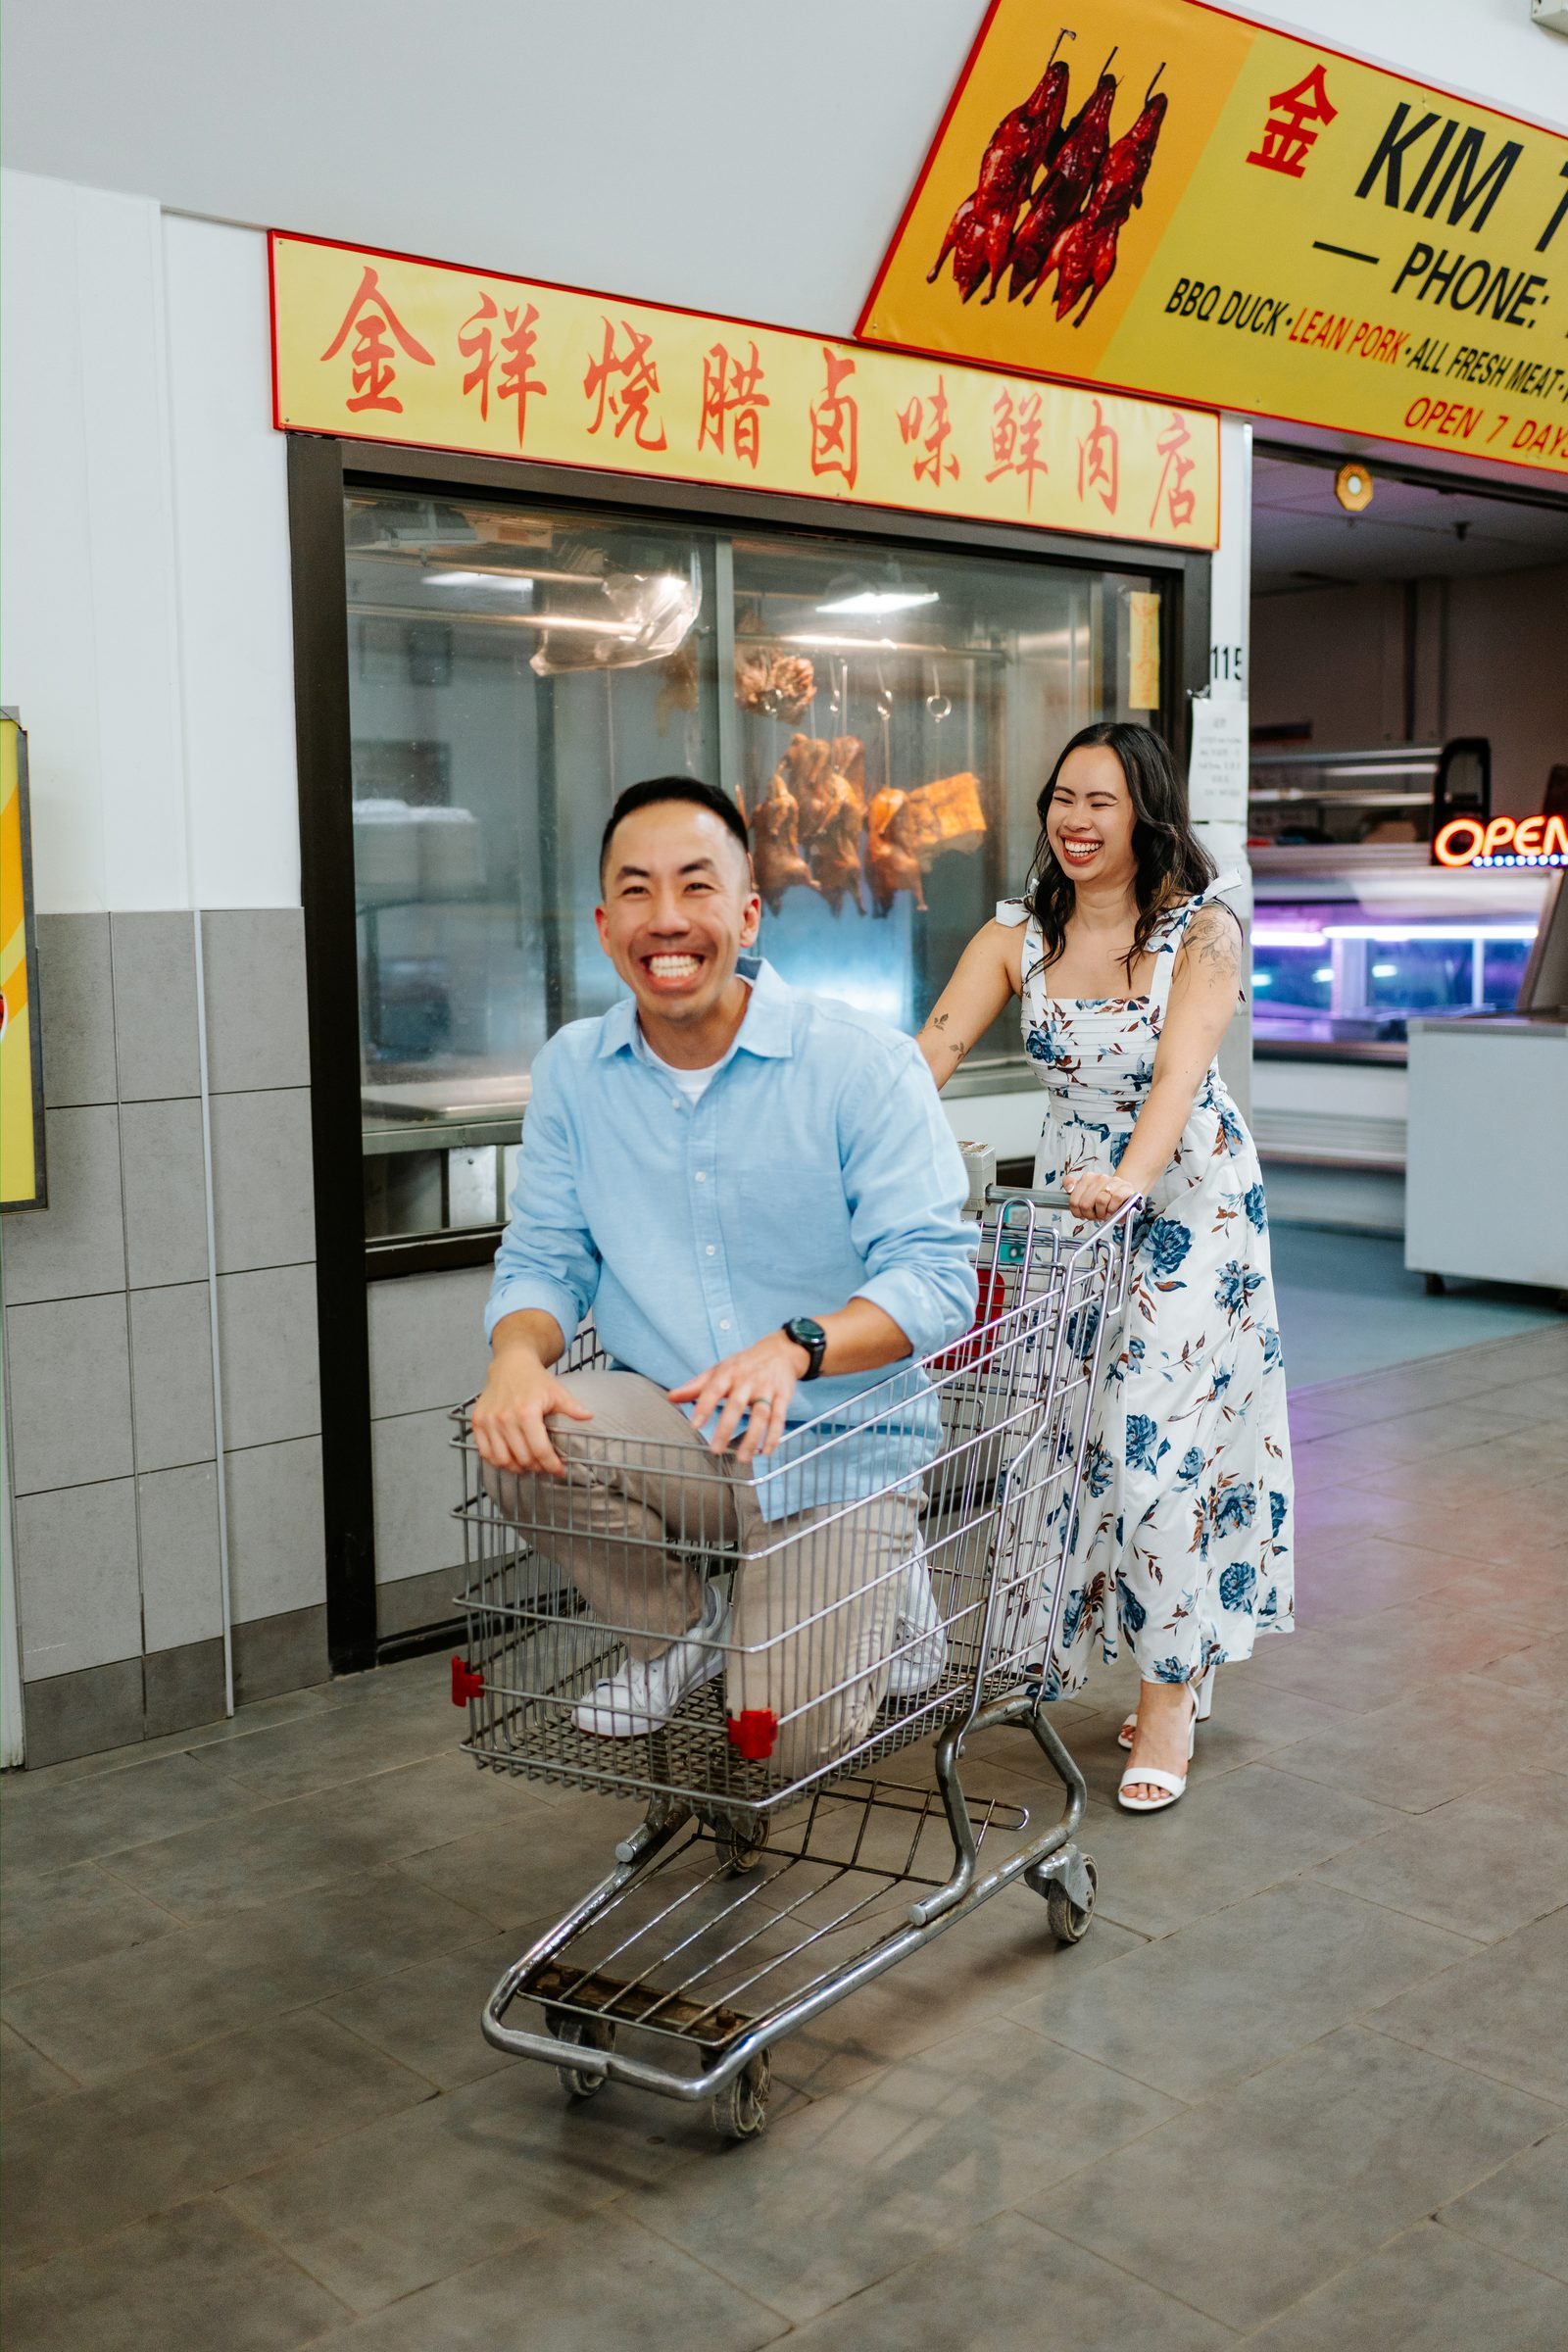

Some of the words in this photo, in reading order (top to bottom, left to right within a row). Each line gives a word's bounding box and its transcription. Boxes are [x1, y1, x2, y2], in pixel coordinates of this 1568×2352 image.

[1246, 64, 1339, 178] 金
[1354, 102, 1525, 233] KIM
[1164, 277, 1221, 321] BBQ
[1289, 307, 1354, 352] LEAN
[1346, 321, 1411, 365] PORK
[1406, 337, 1449, 374] ALL
[1446, 345, 1514, 388] FRESH
[1504, 360, 1565, 399] MEAT
[1392, 242, 1549, 328] PHONE:
[1403, 397, 1484, 439] OPEN
[1486, 415, 1510, 444] 7
